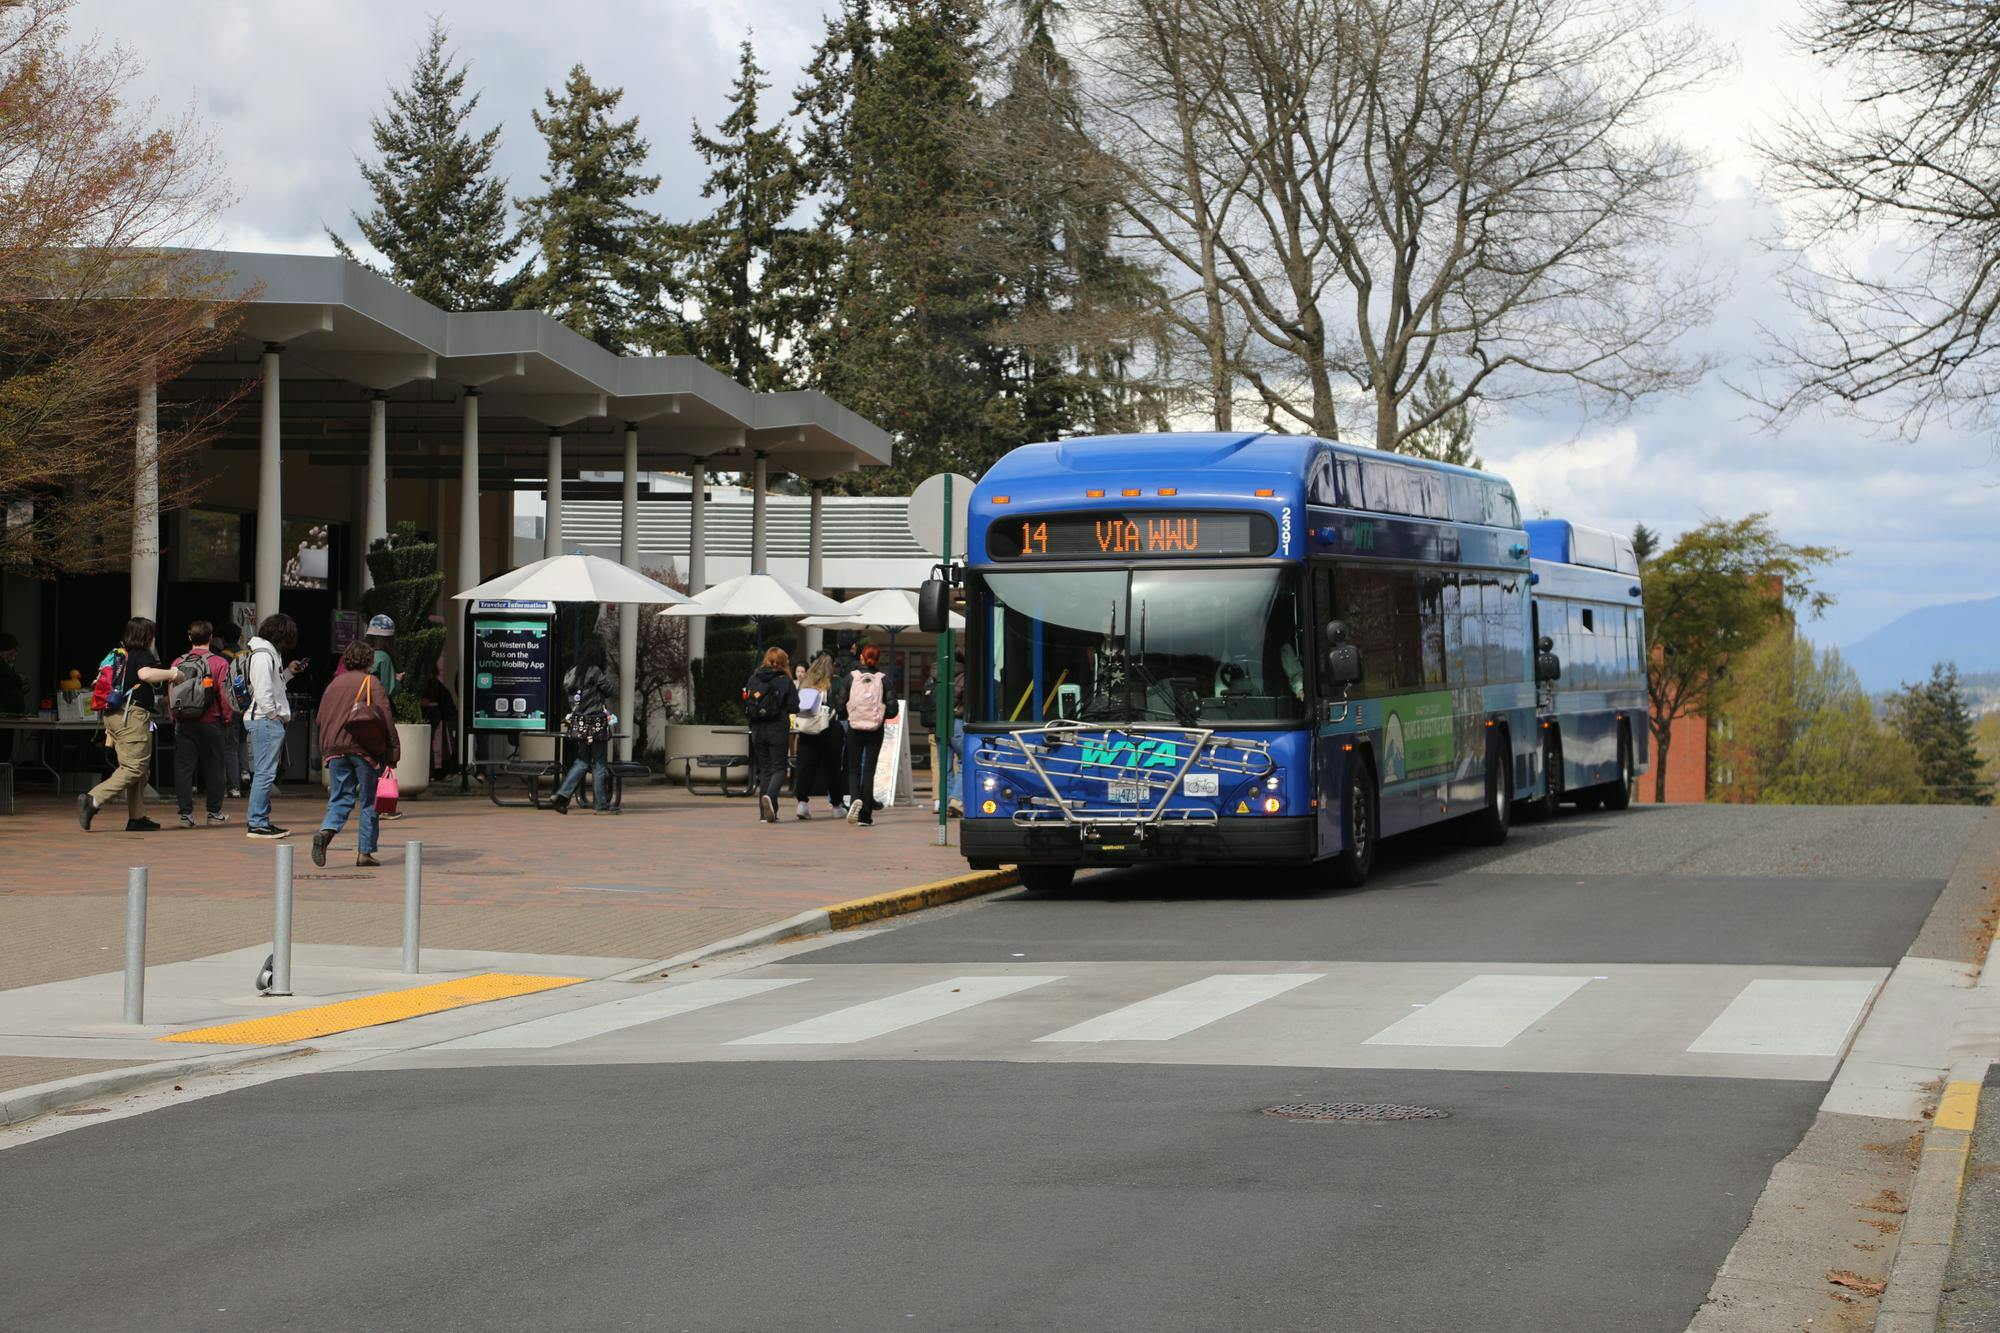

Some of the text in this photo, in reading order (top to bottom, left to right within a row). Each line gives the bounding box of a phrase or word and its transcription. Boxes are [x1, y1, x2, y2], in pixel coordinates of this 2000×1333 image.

[1022, 518, 1199, 554] 14 VIA WWU
[1282, 507, 1291, 556] 2391
[480, 601, 546, 609] Traveler Information
[483, 641, 540, 649] Your Western Bus
[479, 660, 545, 669] umo Mobility App
[1081, 741, 1176, 768] WTA
